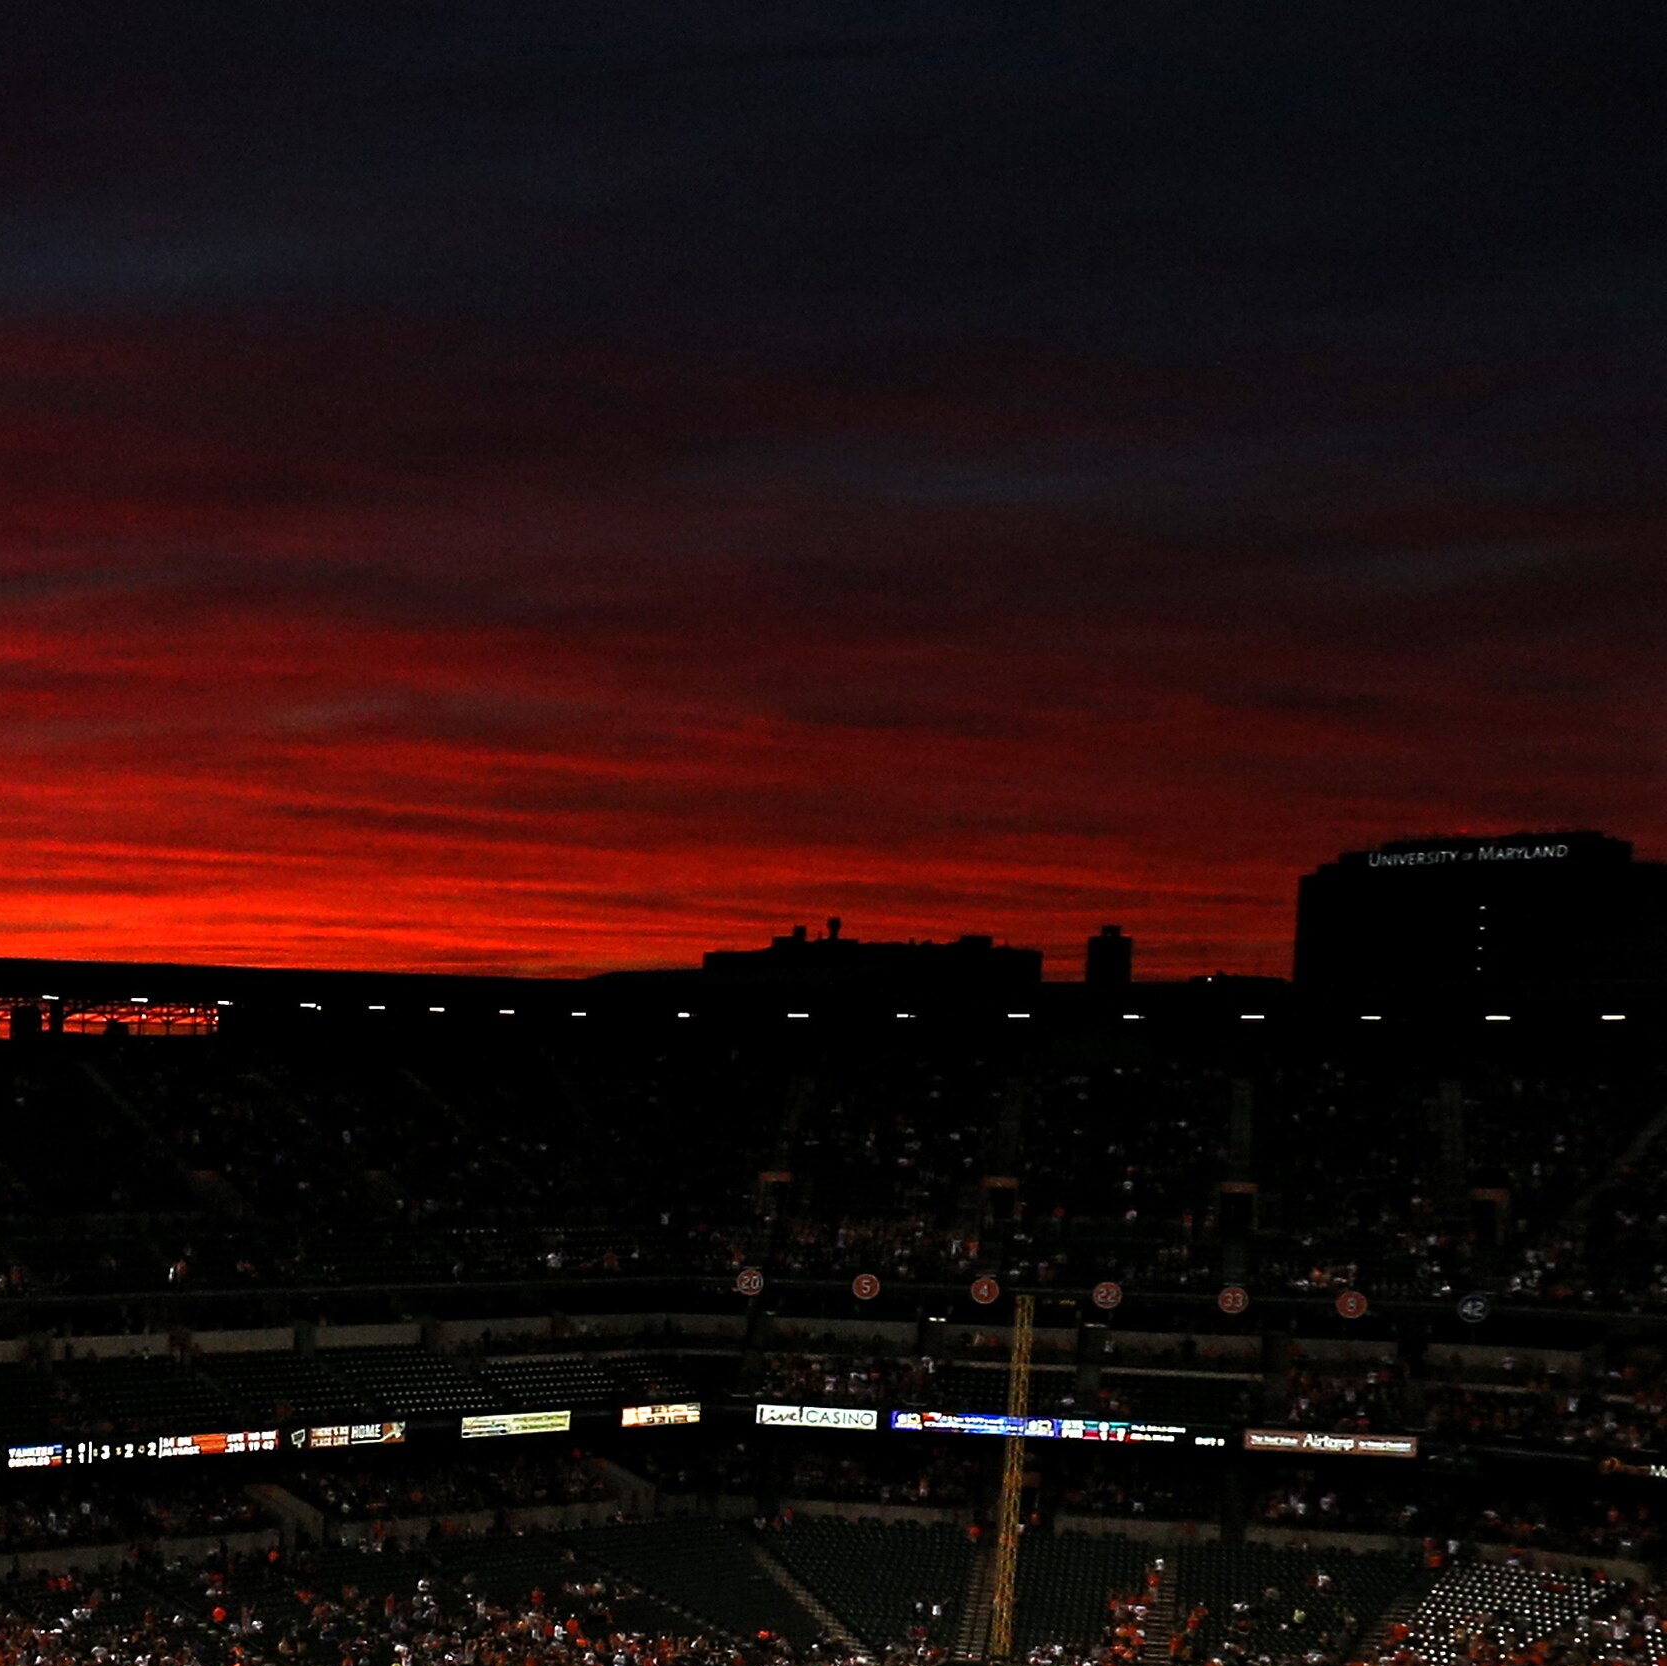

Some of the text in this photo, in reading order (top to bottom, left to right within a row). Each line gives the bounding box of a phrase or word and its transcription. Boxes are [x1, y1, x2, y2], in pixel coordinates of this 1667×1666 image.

[1368, 849, 1459, 868] UNIVERSITY
[1478, 844, 1569, 861] MARYLAND
[741, 1275, 761, 1289] 20
[862, 1280, 871, 1293] 5
[979, 1284, 990, 1298] 4
[1099, 1288, 1118, 1302] 22
[1223, 1293, 1244, 1308] 33
[1463, 1303, 1484, 1319] 42
[805, 1410, 874, 1426] CASINO
[350, 1423, 381, 1439] HOME
